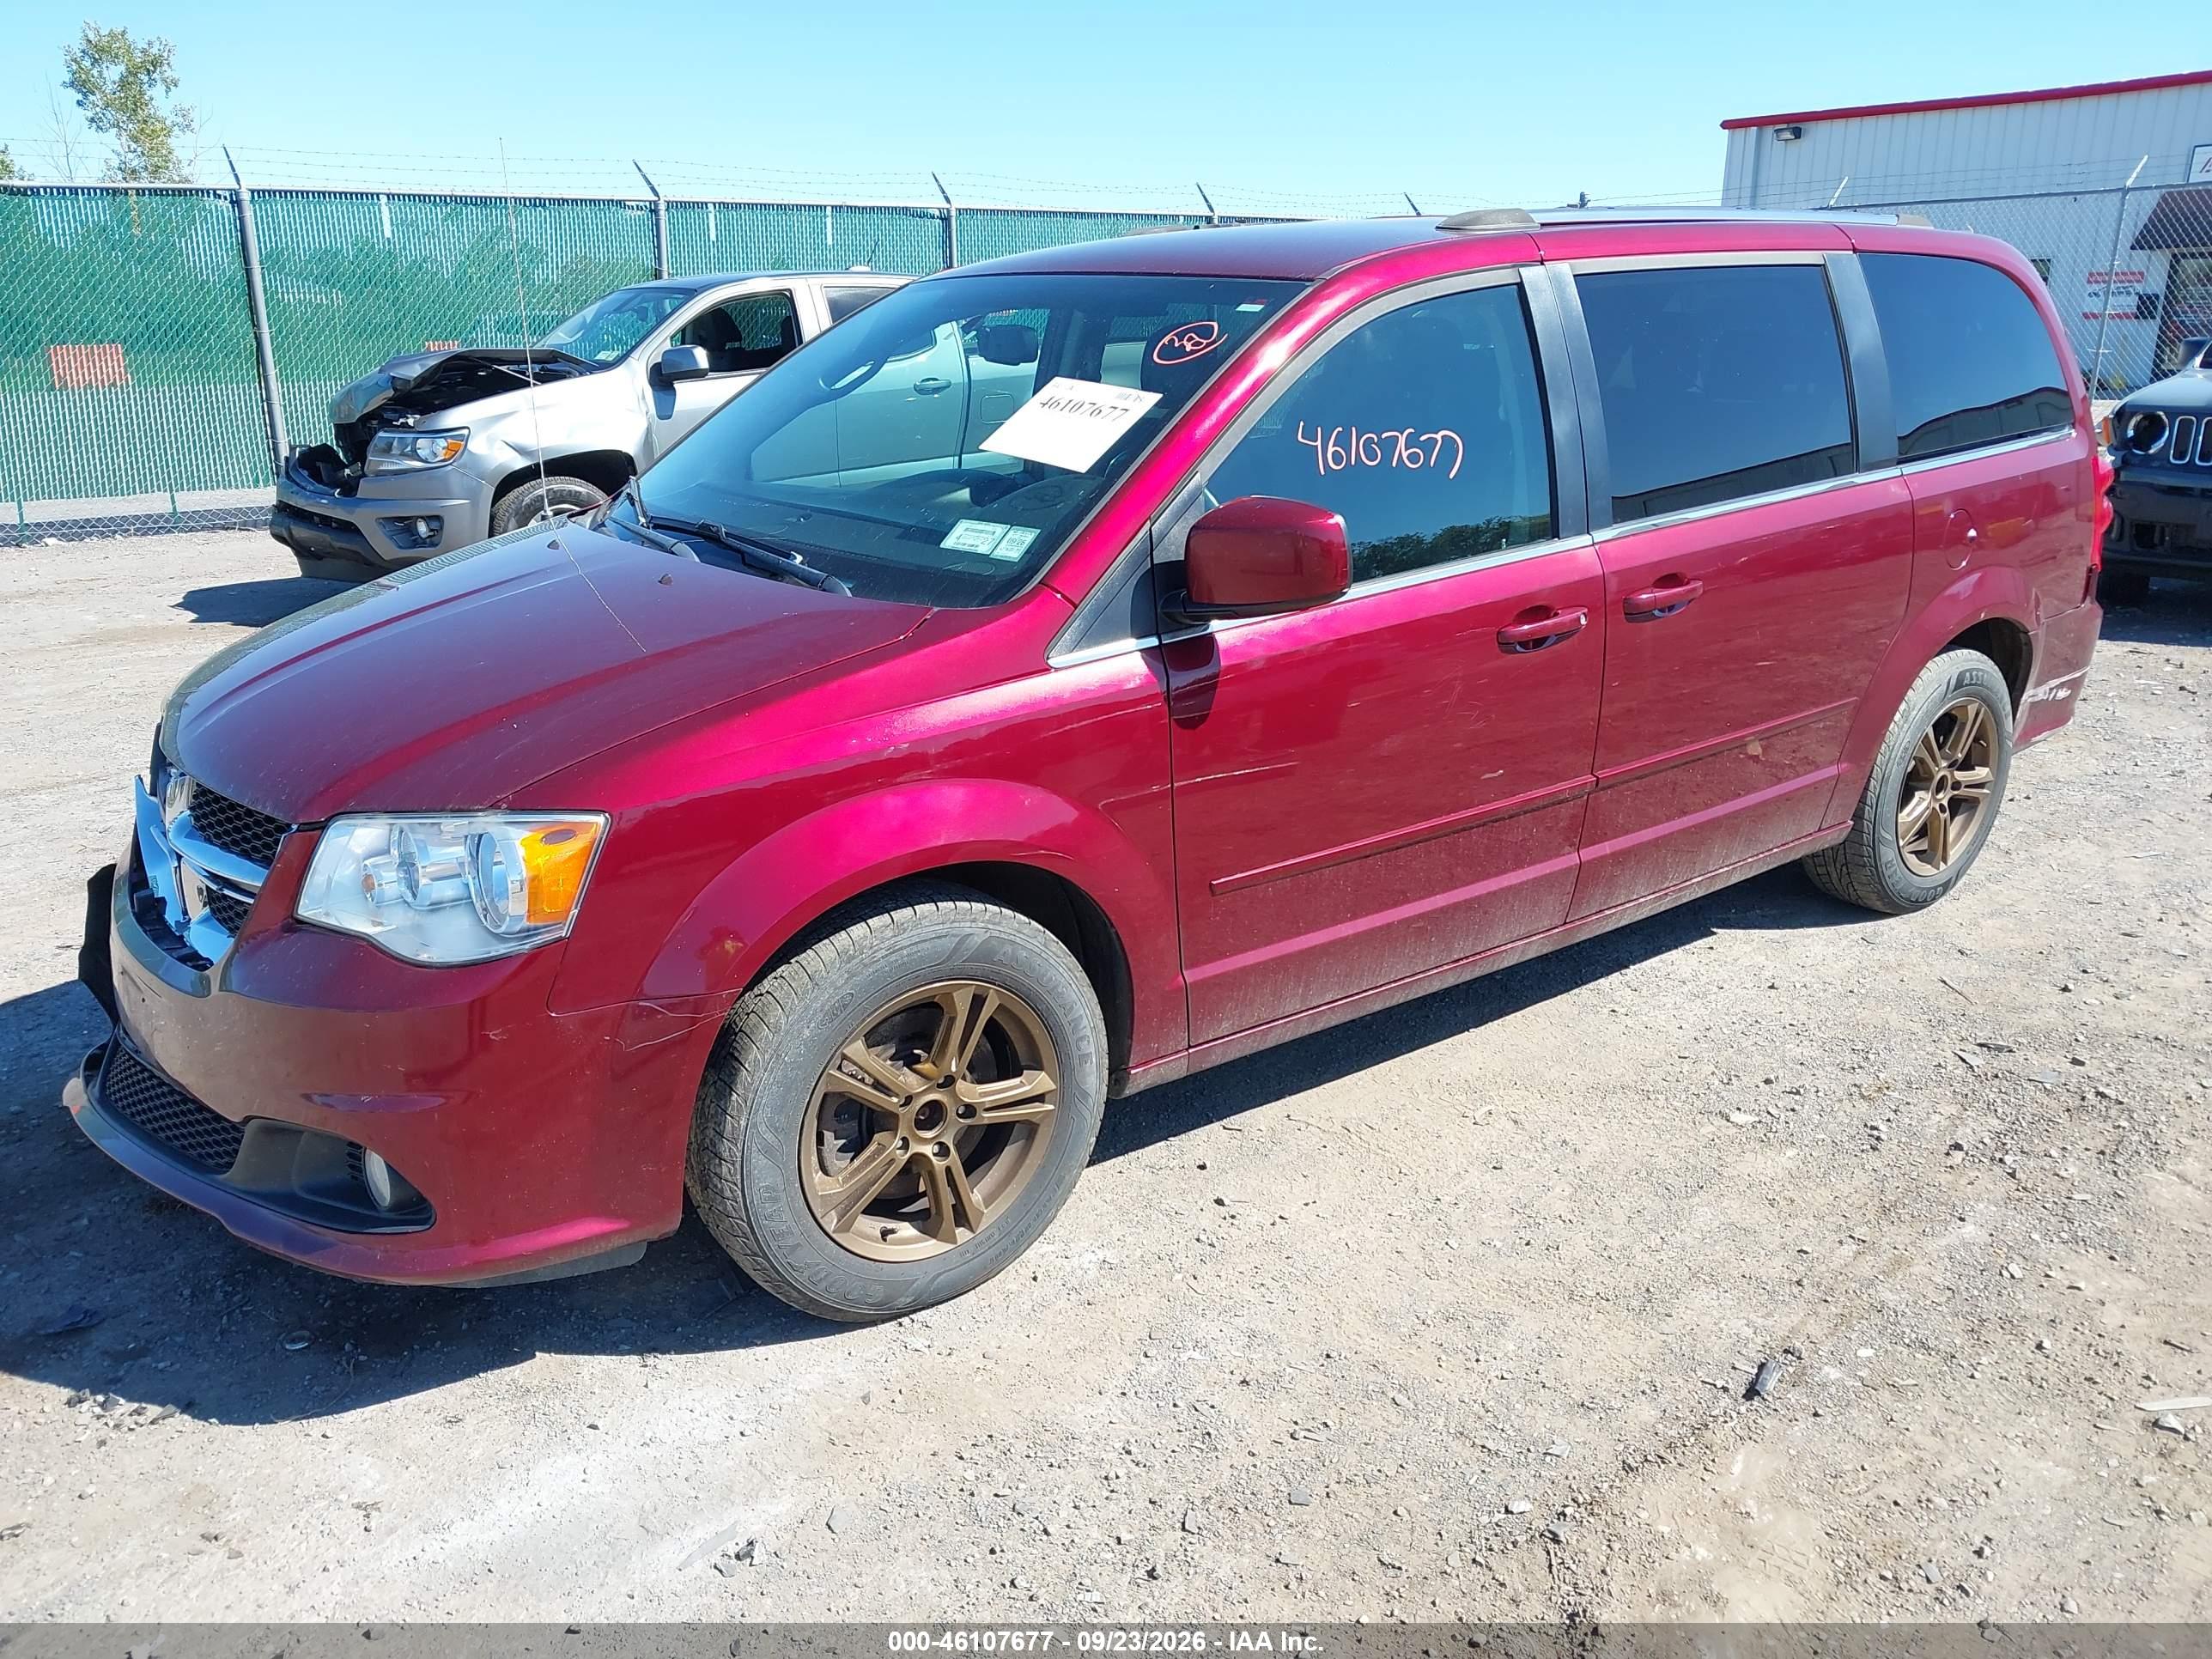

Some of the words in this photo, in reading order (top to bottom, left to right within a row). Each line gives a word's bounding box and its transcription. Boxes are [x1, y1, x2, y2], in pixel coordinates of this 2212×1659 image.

[1040, 396, 1129, 422] 46107677
[1297, 420, 1464, 479] 46107677
[993, 947, 1094, 1068] ASSURANCE
[758, 1182, 884, 1304] GOODYEAR
